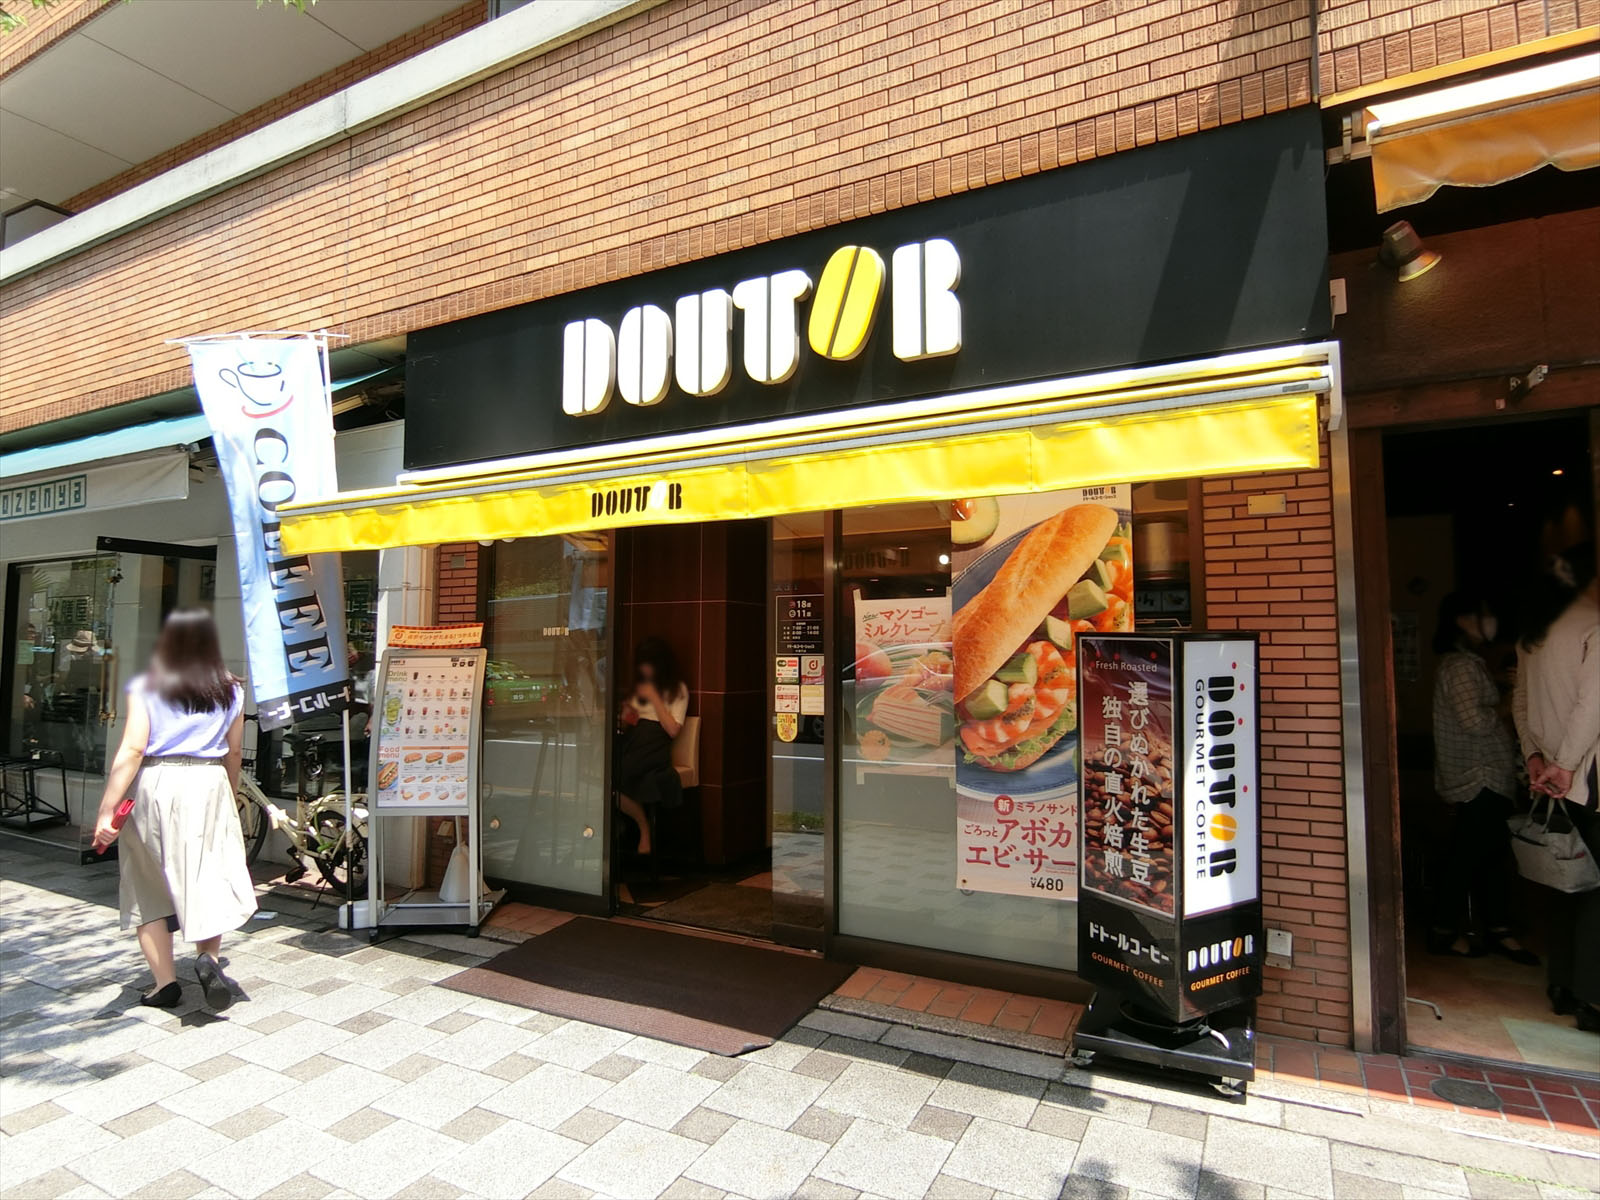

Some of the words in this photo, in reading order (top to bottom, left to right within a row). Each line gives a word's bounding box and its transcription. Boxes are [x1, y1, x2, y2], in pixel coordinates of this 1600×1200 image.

[562, 238, 962, 416] DOUTOR
[591, 480, 682, 517] DOUTOR
[864, 619, 946, 638] ミルクレープ
[879, 606, 938, 621] マンゴー
[1095, 660, 1118, 670] Fresh
[1120, 662, 1158, 673] Roasted
[1195, 678, 1206, 788] GOURMET
[1102, 695, 1124, 878] 独自の直火焙煎
[1128, 681, 1151, 887] 選びぬかれた生豆
[1207, 675, 1237, 878] DOUTOR
[963, 823, 999, 838] ごろっと
[997, 816, 1077, 848] アボカ
[1195, 799, 1206, 880] COFFEE
[1089, 921, 1170, 965] ドトールコーヒー
[1187, 934, 1254, 972] DOUTOR
[1091, 952, 1131, 974] GOURMET
[1132, 968, 1165, 988] COFFEE
[1190, 973, 1224, 992] GOURMET
[1226, 966, 1250, 980] COFFEE
